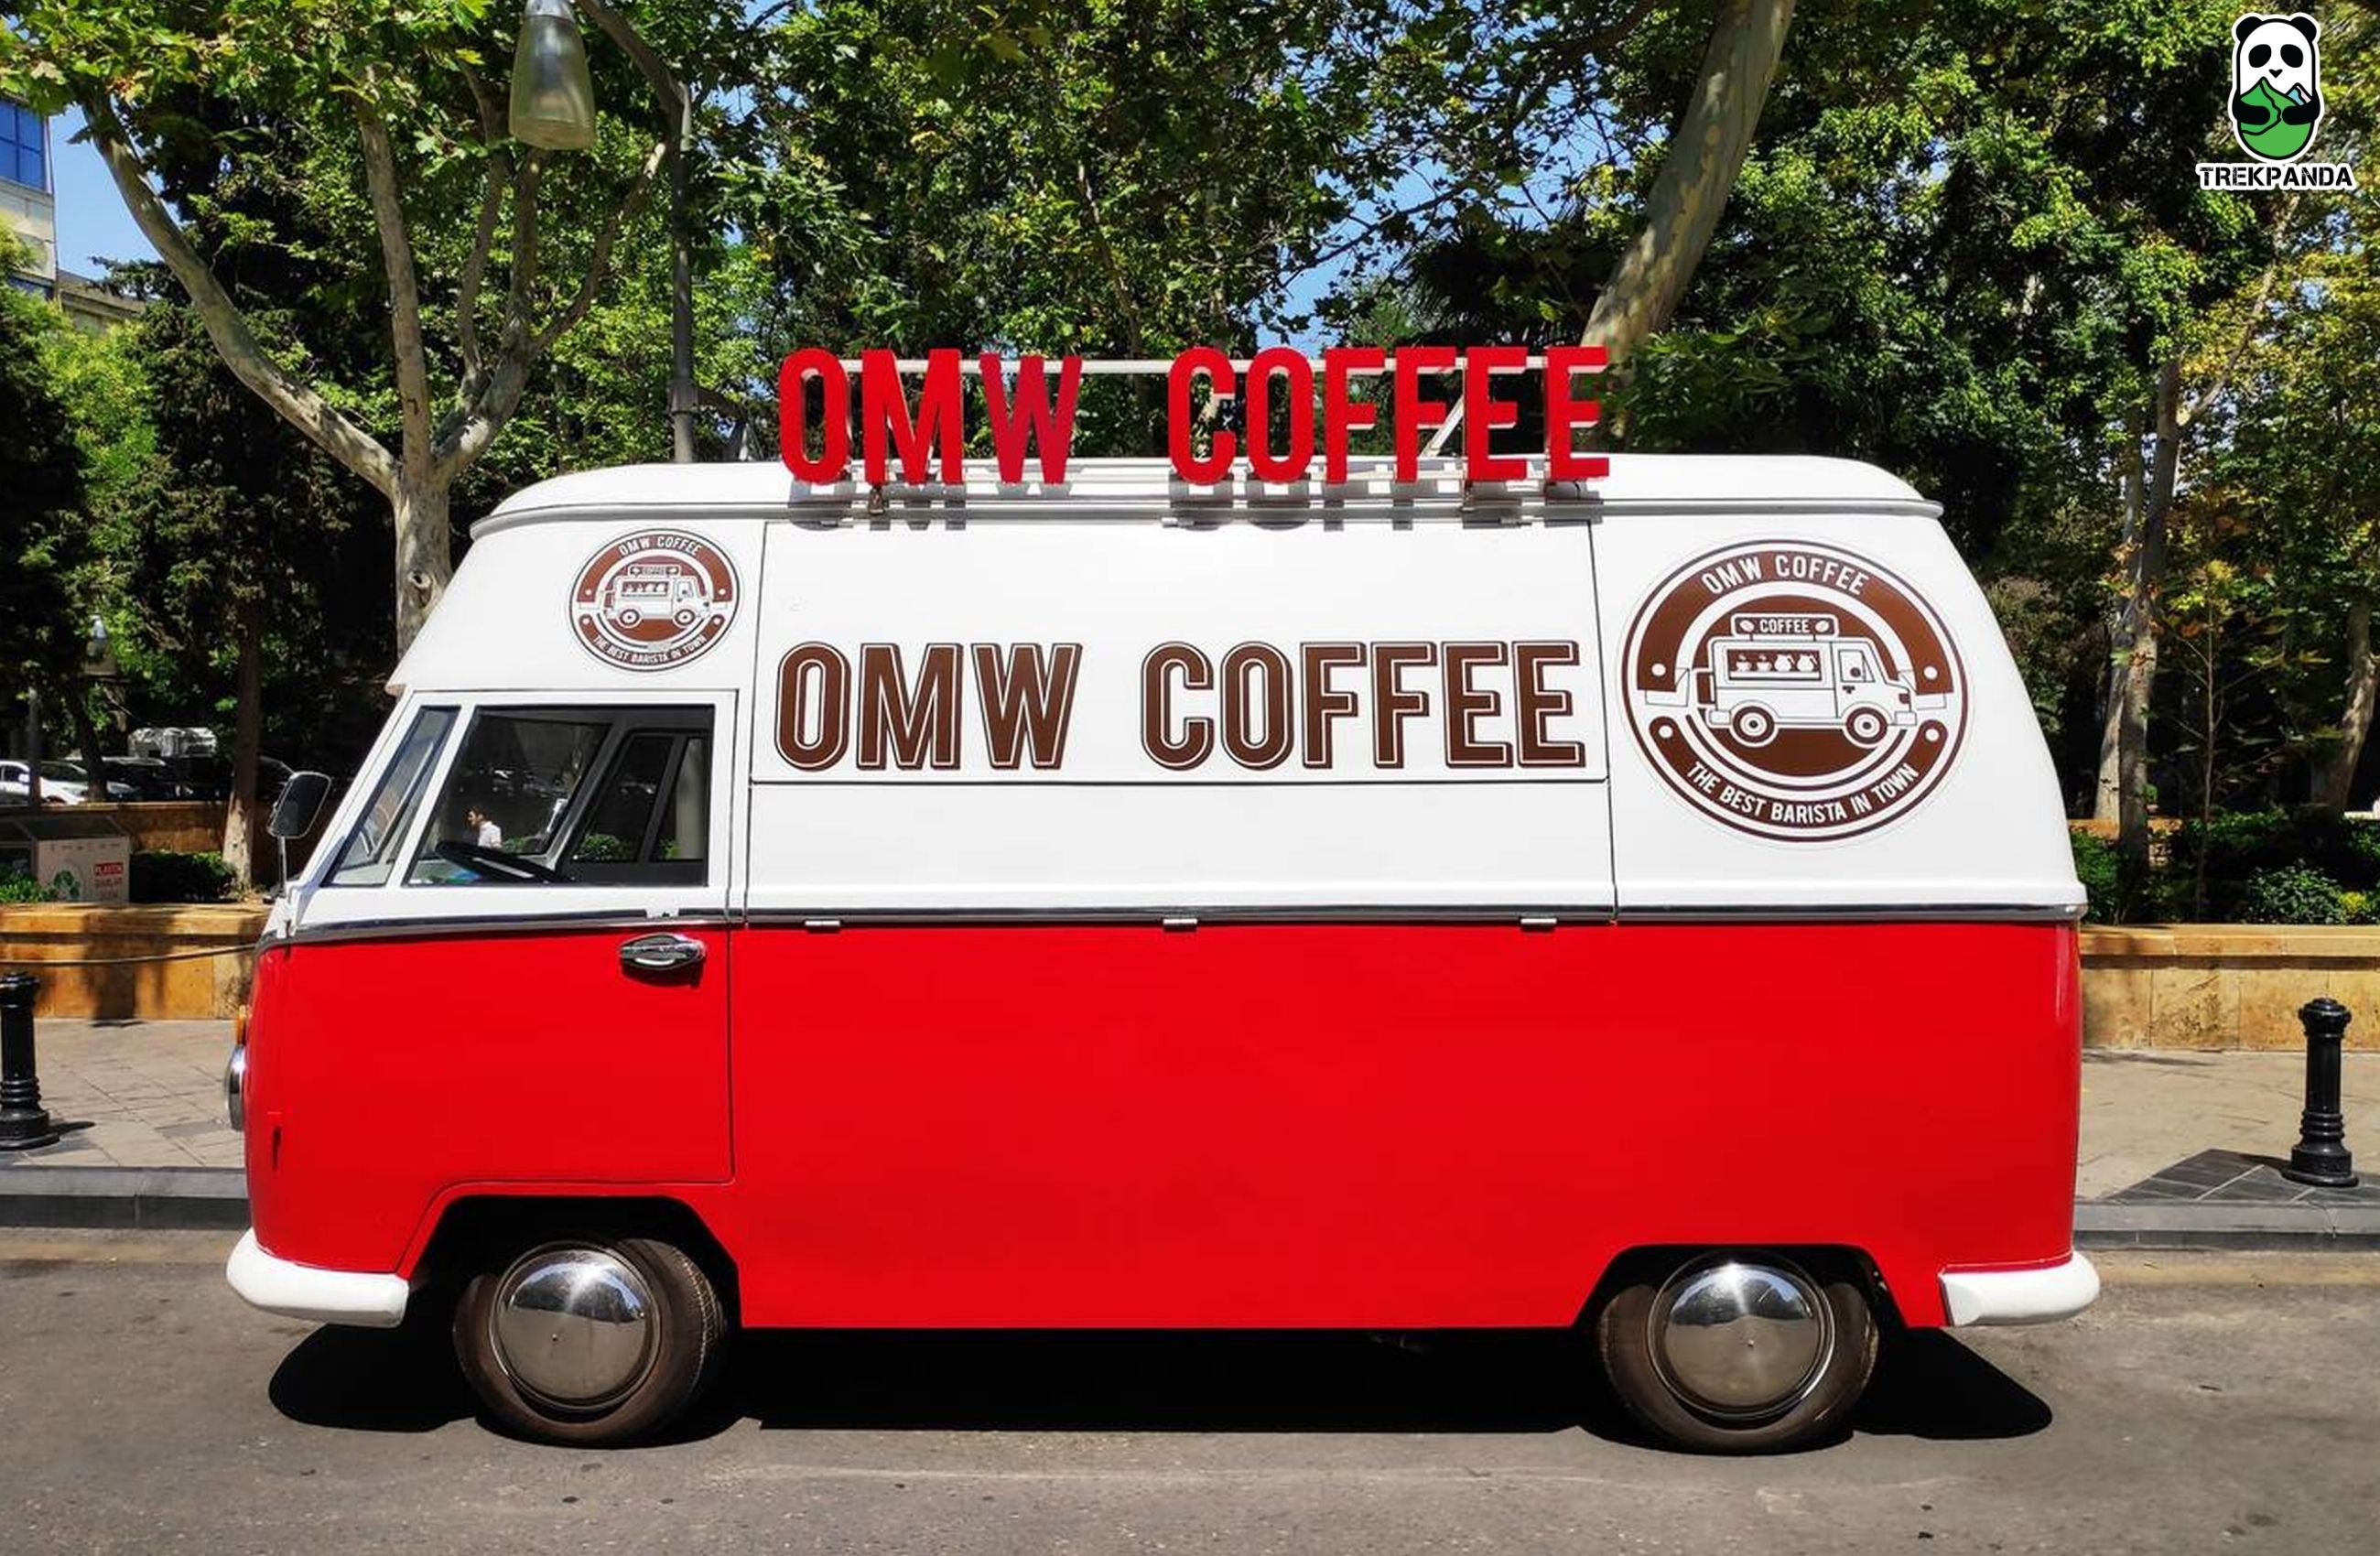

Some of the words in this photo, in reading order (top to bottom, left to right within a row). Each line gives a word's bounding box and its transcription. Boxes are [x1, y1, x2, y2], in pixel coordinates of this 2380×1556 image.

[779, 348, 1083, 486] OMW
[1168, 346, 1609, 485] COFFEE
[619, 537, 650, 556] OMW
[657, 535, 702, 556] COFFEE
[1701, 556, 1762, 595] OMW
[1774, 555, 1870, 596] COFFEE
[1759, 617, 1811, 633] COFFEE
[774, 640, 1083, 772] OMW
[1141, 640, 1585, 771] COFFEE
[1686, 762, 1716, 794] THE
[1719, 783, 1768, 817] BEST
[1770, 800, 1848, 824] BARISTA
[1850, 794, 1873, 816] IN
[1871, 762, 1920, 803] TOWN
